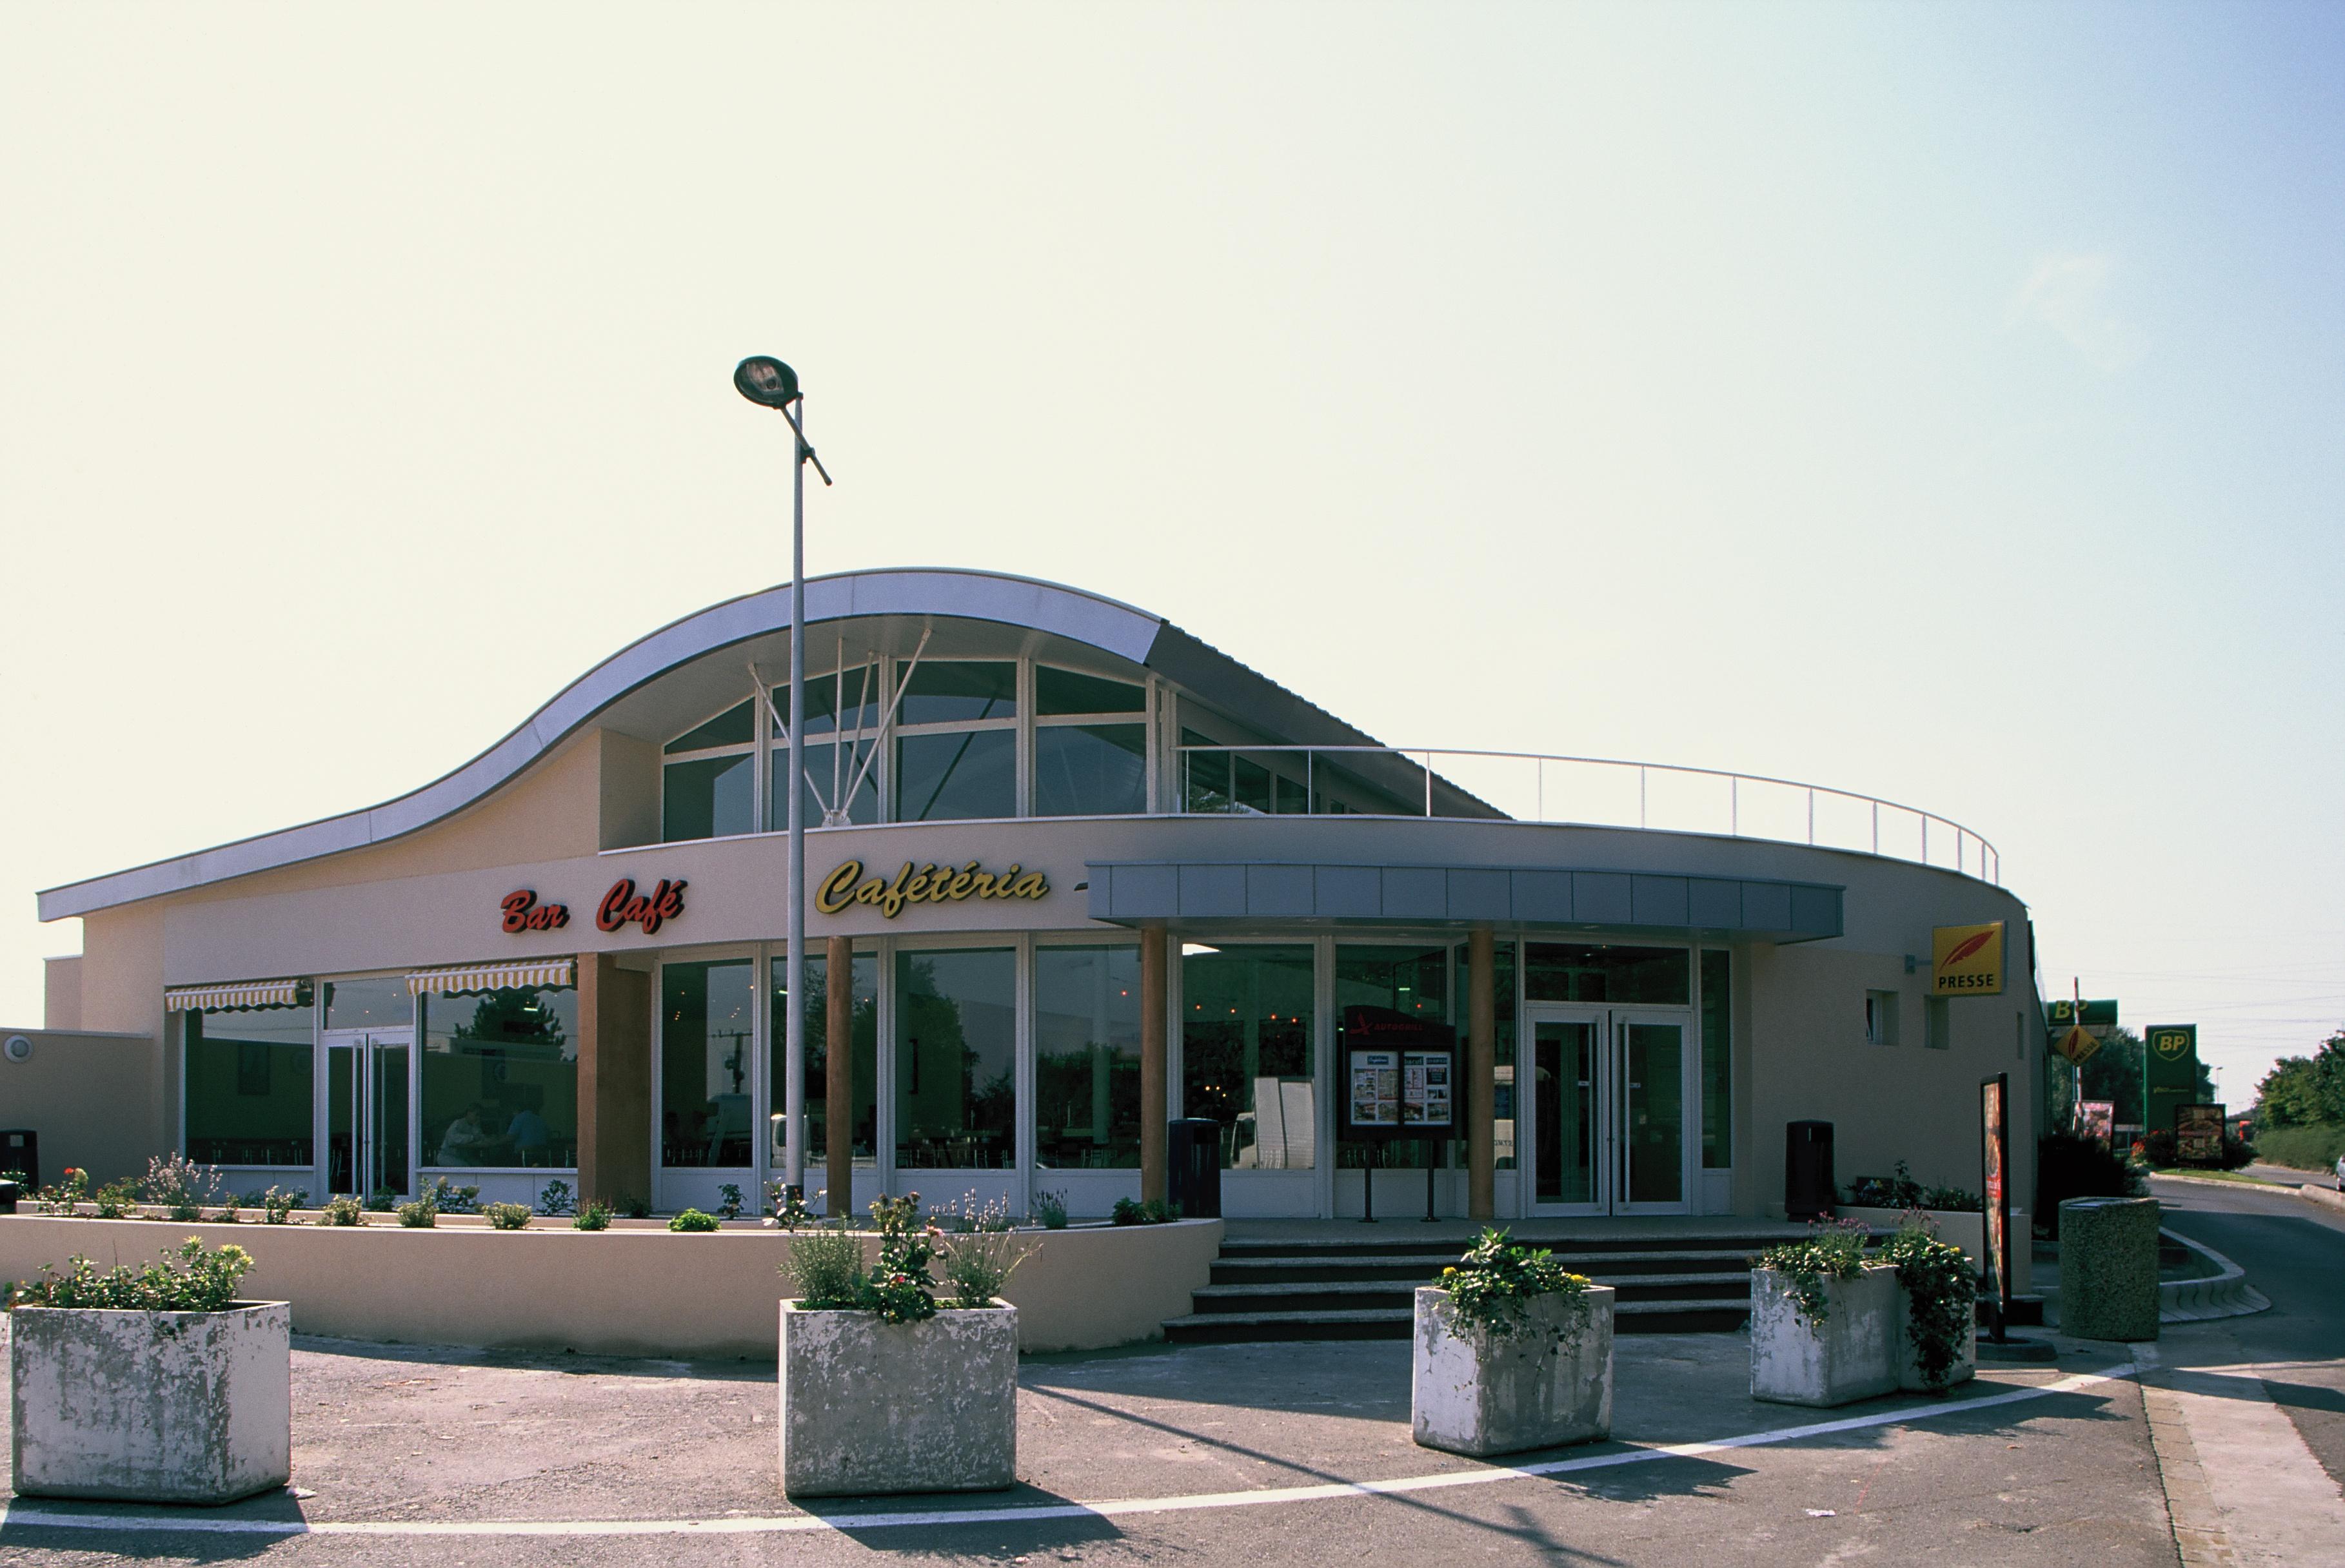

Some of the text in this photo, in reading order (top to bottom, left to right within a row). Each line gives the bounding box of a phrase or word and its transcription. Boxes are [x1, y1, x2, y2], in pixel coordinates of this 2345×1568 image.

[815, 859, 1049, 919] Cafétéria
[500, 878, 688, 934] Bar Café
[1939, 974, 1994, 988] PRESSE
[2054, 999, 2088, 1019] BP
[1374, 1022, 1424, 1031] AUTOGRILL
[2160, 1035, 2186, 1051] BP
